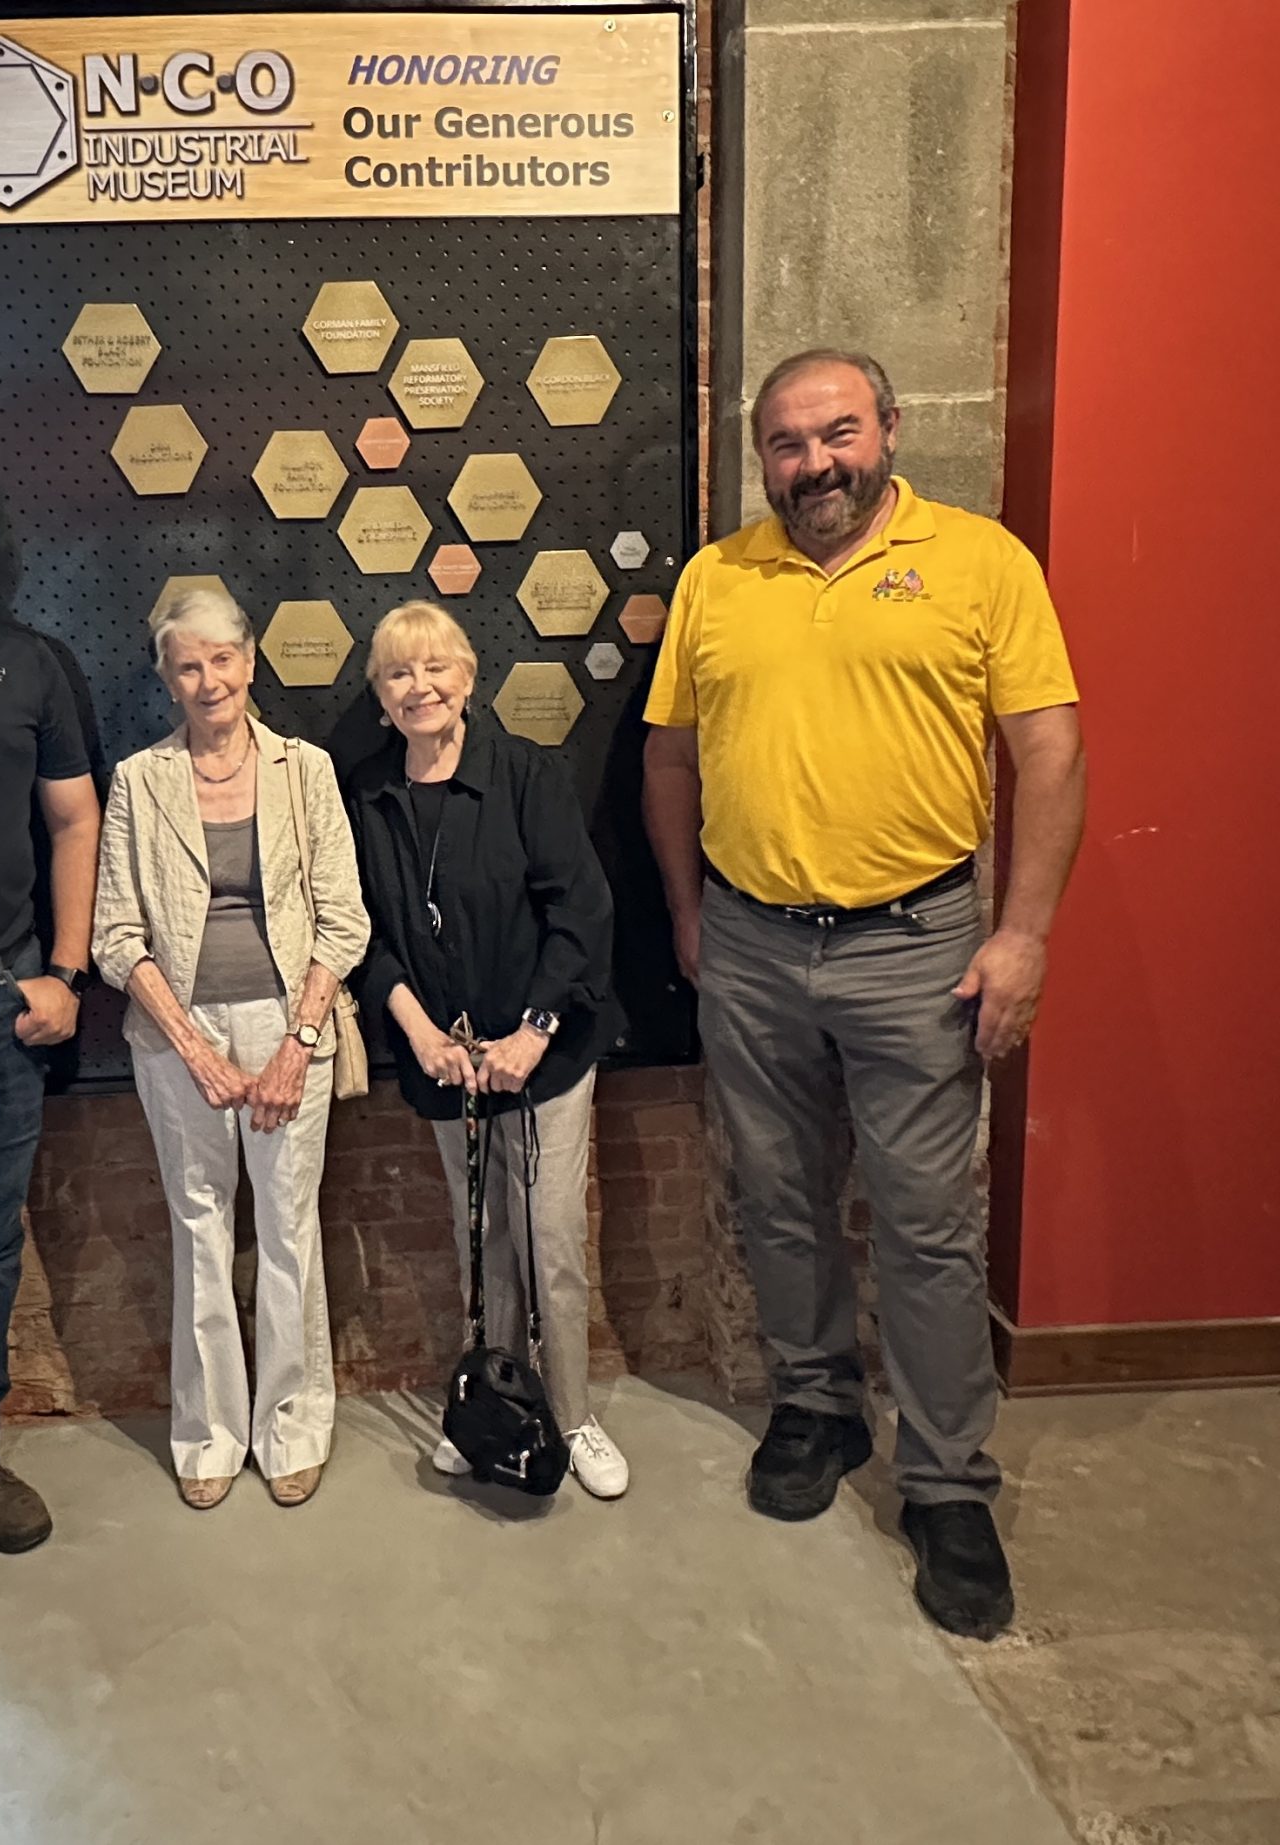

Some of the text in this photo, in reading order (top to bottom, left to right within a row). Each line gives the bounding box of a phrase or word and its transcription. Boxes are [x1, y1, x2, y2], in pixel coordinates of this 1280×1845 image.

[347, 54, 561, 86] HONORING
[343, 106, 635, 139] Our Generous
[84, 132, 310, 166] INDUSTRIAL
[344, 154, 611, 188] Contributors
[88, 168, 245, 202] MUSEUM
[312, 318, 387, 330] GORMAN FAMILY
[321, 329, 381, 340] FOUNDATION
[410, 363, 462, 374] MANSFIELD
[403, 374, 468, 386] REFORMATORY
[404, 385, 468, 396] PRESERVATION
[418, 396, 455, 407] SOCIETY
